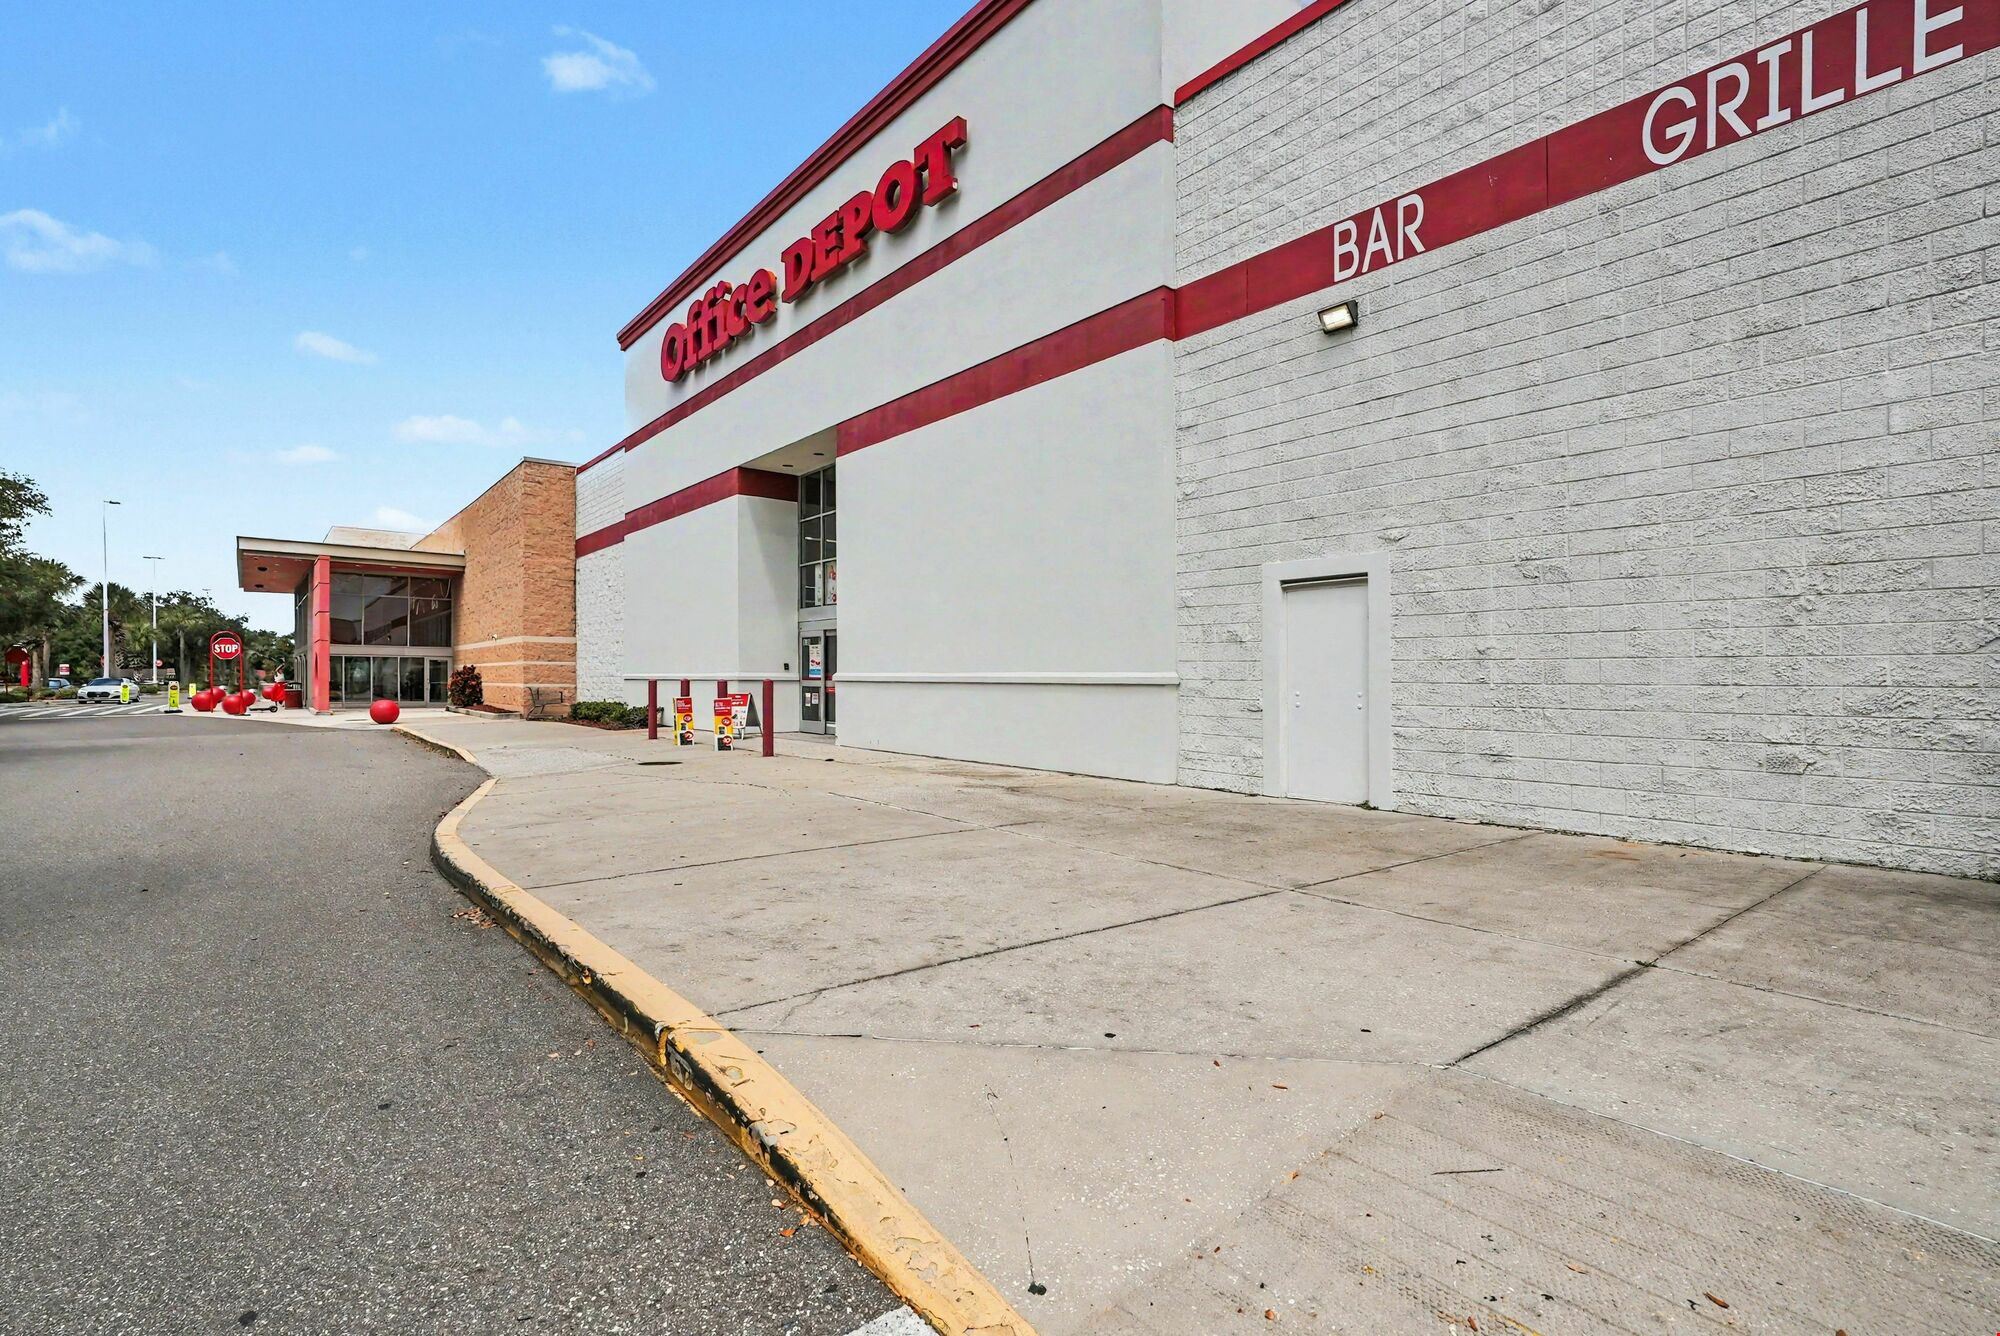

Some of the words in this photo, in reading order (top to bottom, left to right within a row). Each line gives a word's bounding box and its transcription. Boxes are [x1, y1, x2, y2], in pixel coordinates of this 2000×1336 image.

[661, 268, 777, 382] Office
[781, 116, 967, 303] DEPOT
[1333, 193, 1425, 283] BAR
[1642, 0, 1964, 165] GRILLE
[214, 644, 238, 653] STOP
